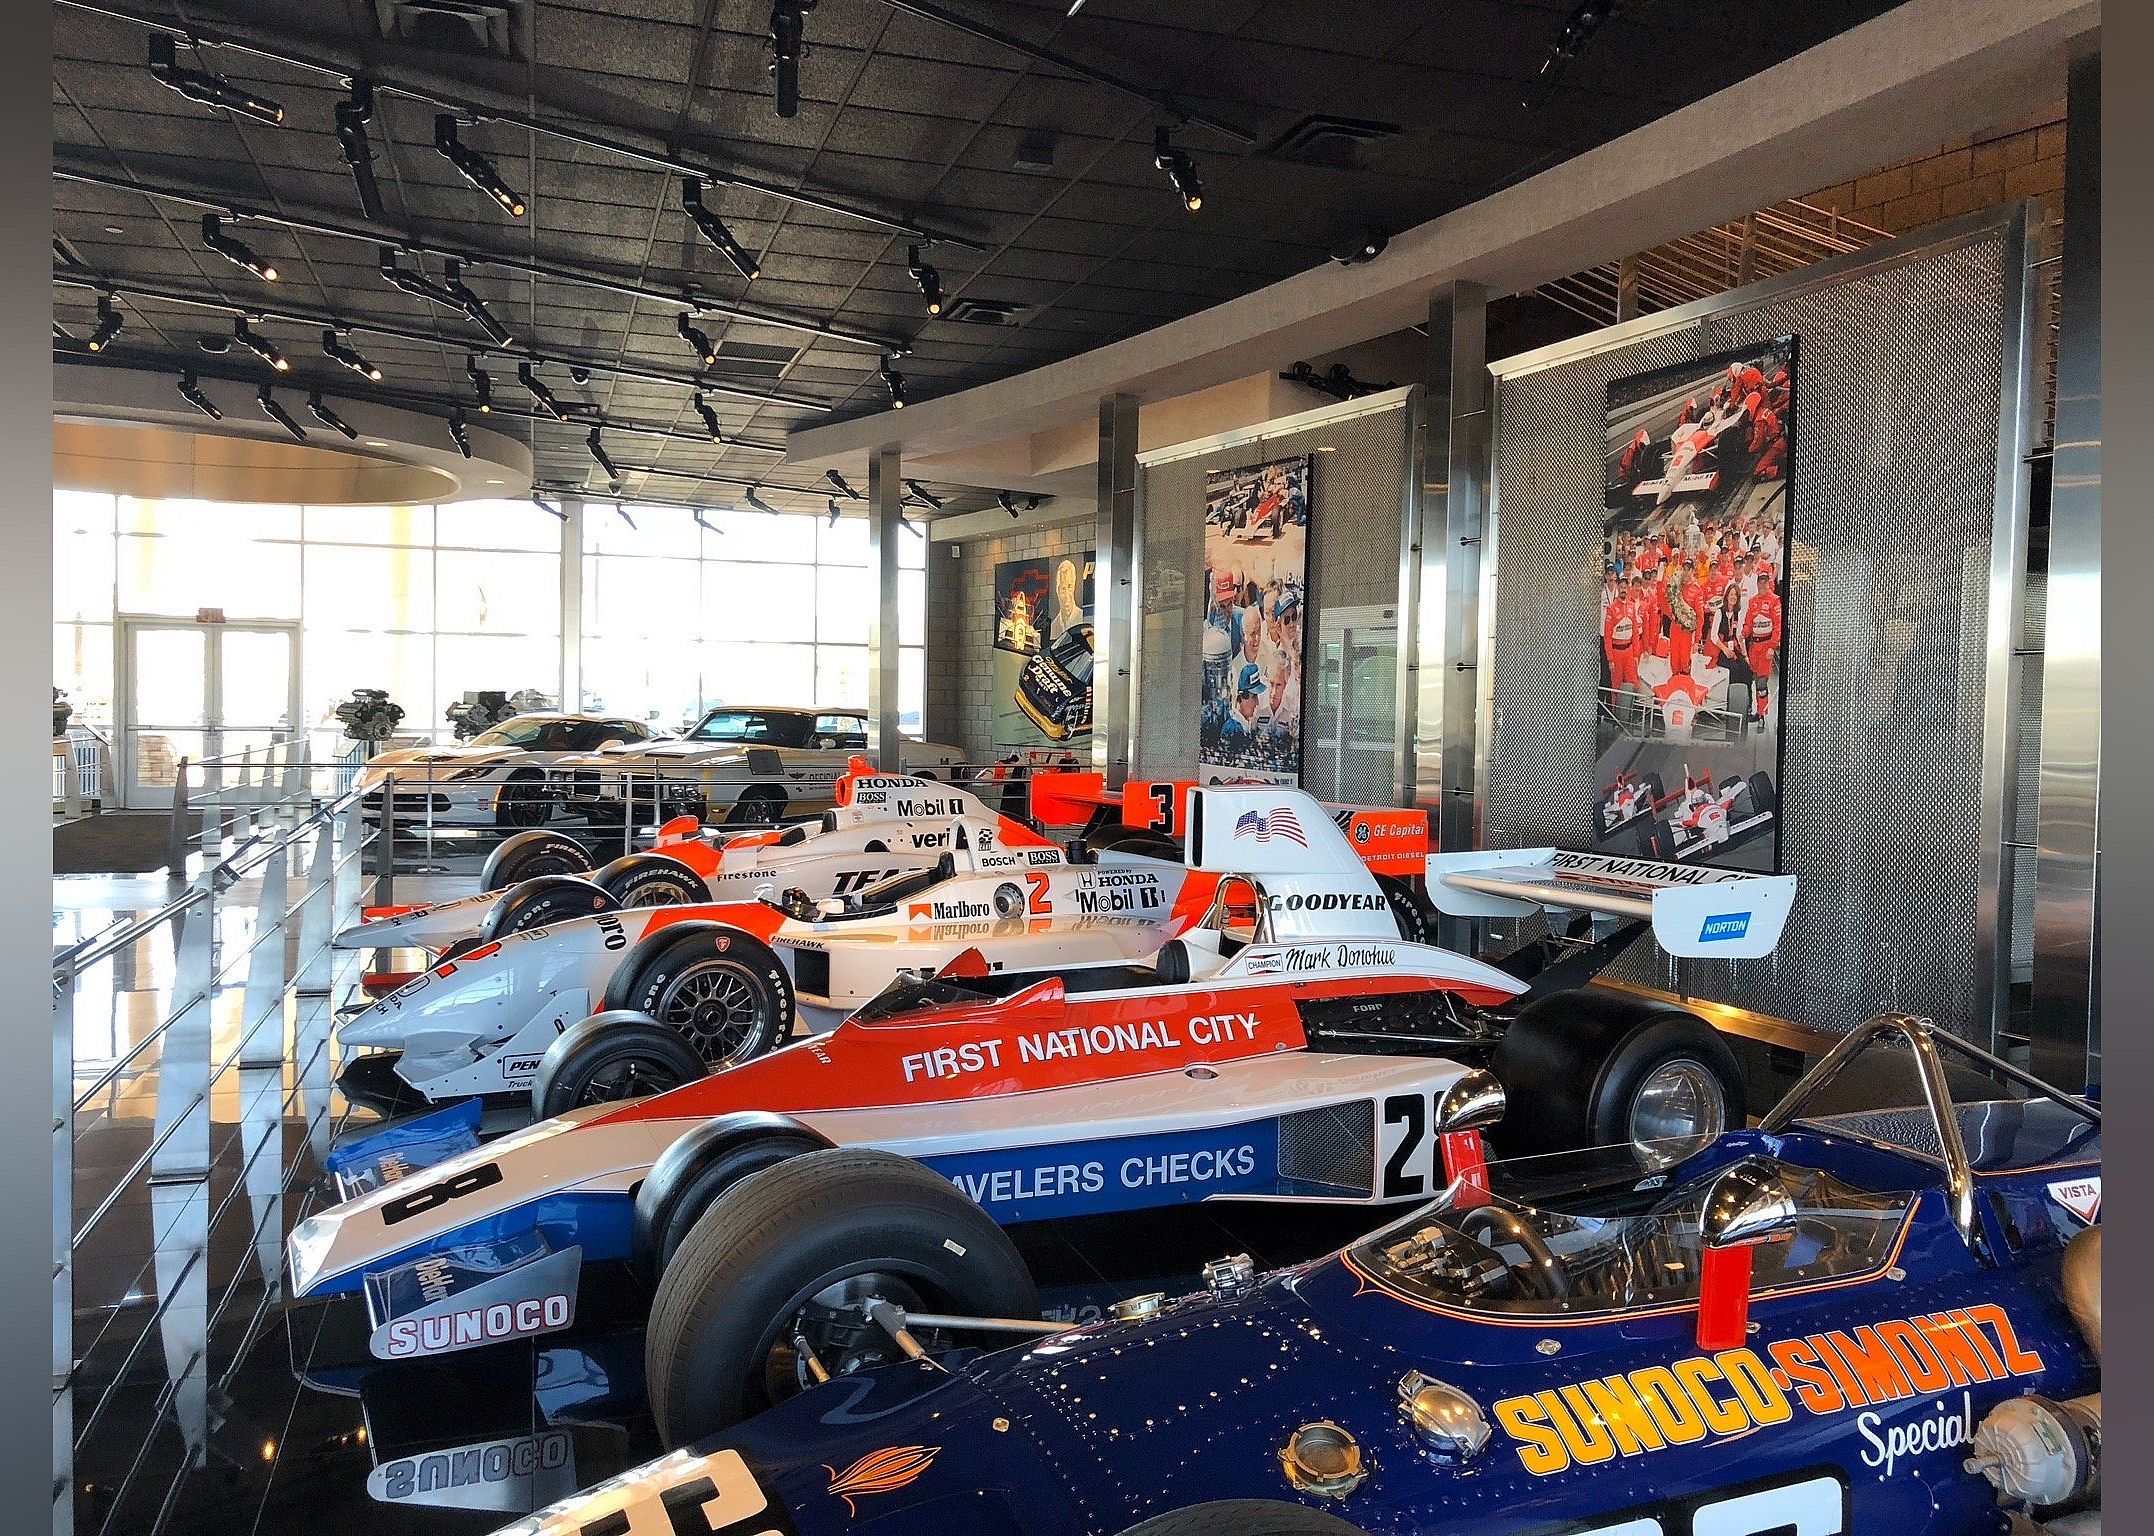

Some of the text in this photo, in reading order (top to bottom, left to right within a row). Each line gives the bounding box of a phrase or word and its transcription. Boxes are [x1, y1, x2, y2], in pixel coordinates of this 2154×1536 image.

[1028, 664, 1059, 694] Draft
[1032, 655, 1072, 698] Genuine
[856, 778, 929, 789] HONDA
[858, 792, 886, 801] BOSS
[897, 799, 965, 817] Mobil 1
[1148, 783, 1175, 836] 3
[911, 828, 950, 849] veri
[1374, 824, 1386, 837] GE
[981, 856, 1016, 867] BOSCH
[1029, 851, 1058, 862] BOSS
[1361, 852, 1425, 862] DETROIT DIESEL
[717, 870, 777, 882] Firestone
[1545, 852, 1710, 885] FIRST NATIONAL
[624, 868, 699, 890] FIREHAWK
[1097, 873, 1159, 888] HONDA
[1025, 871, 1053, 915] 2
[1079, 887, 1159, 914] Mobil 1
[933, 900, 990, 920] Marlboro
[1269, 894, 1386, 912] GOODYEAR
[1705, 920, 1747, 934] NORTON
[1247, 959, 1281, 970] CHAMPION
[1286, 944, 1396, 972] Mark Donohue
[1353, 1003, 1383, 1013] FORD
[901, 1012, 1257, 1083] FIRST NATIONAL CITY
[508, 1060, 541, 1072] PEN
[508, 1080, 533, 1088] Truck
[952, 1144, 1256, 1203] AVELERS CHECKS
[381, 1162, 503, 1226] 8
[2058, 1184, 2096, 1199] VISTA
[388, 1294, 569, 1356] SUNOCO
[1494, 1303, 2045, 1476] SUNOCO SIMONIZ
[1856, 1391, 1972, 1477] Special
